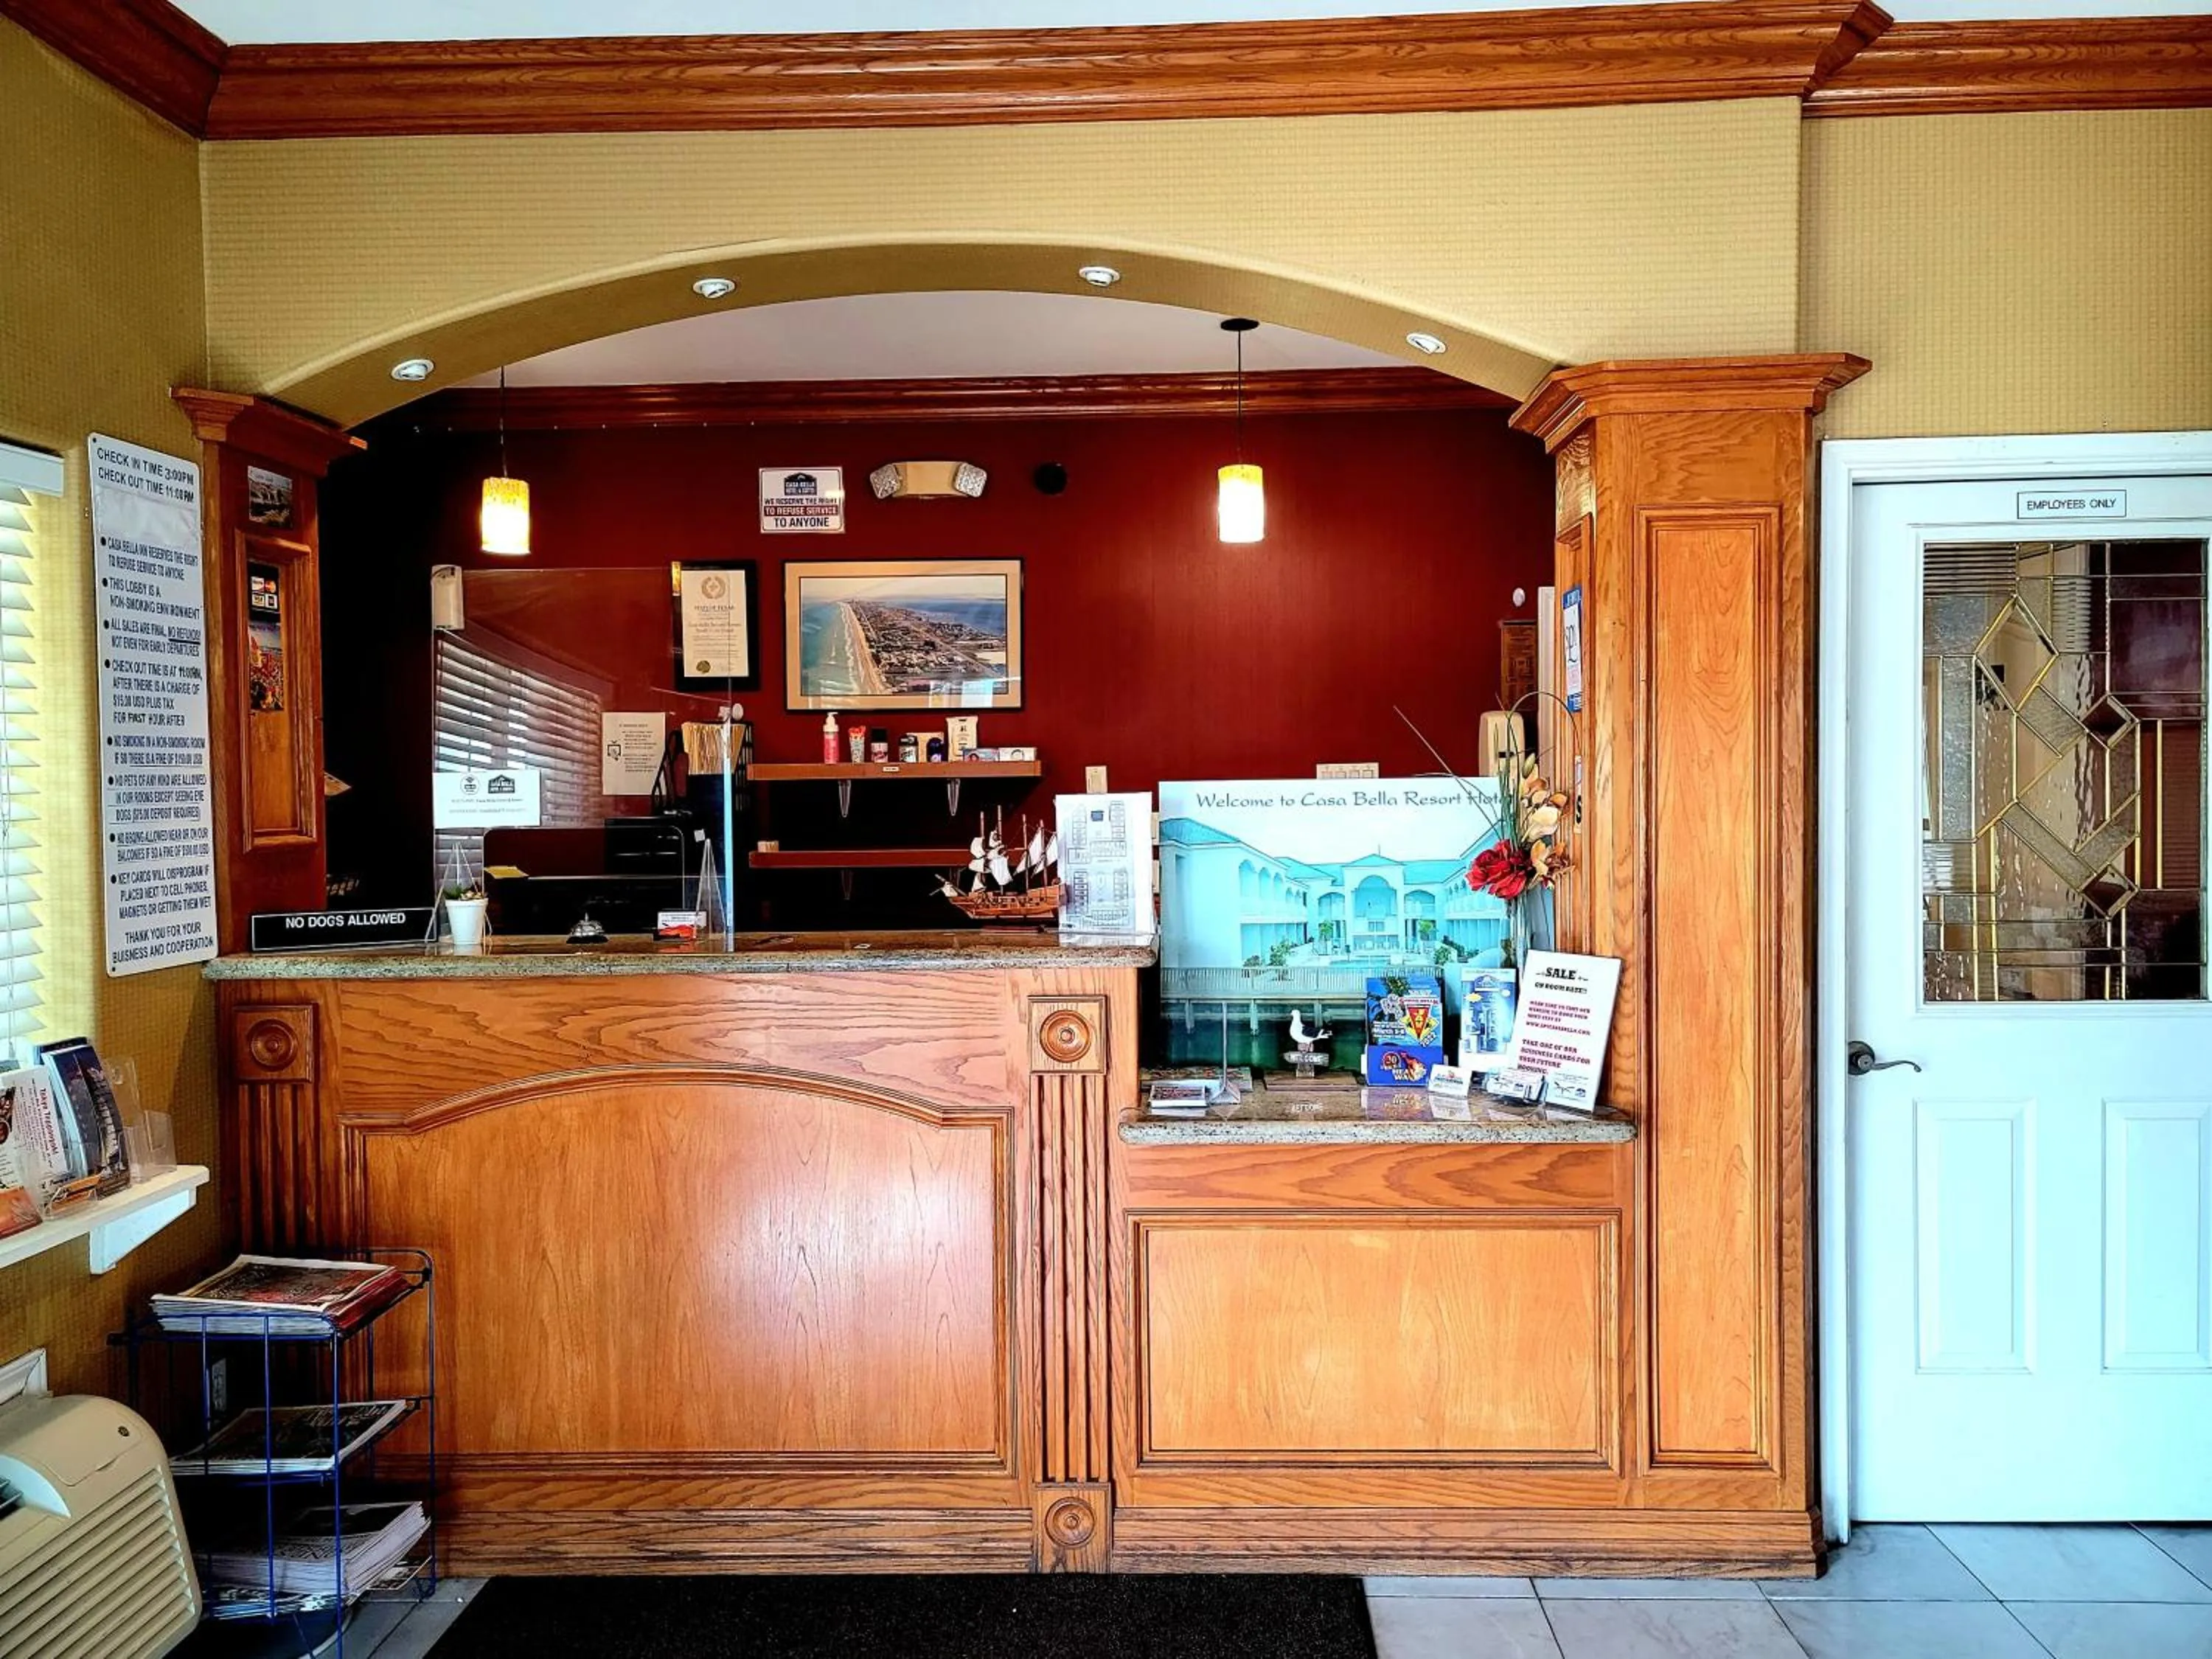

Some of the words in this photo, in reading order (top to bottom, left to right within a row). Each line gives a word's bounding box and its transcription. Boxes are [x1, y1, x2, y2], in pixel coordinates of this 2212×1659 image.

[97, 448, 129, 467] CHECK
[131, 456, 140, 470] IN
[143, 461, 163, 476] TIME
[98, 467, 126, 484] CHECK
[128, 476, 144, 489] OUT
[147, 479, 163, 495] TIME
[2028, 499, 2085, 510] EMPLOYEES
[2090, 498, 2116, 509] ONLY
[774, 518, 786, 527] TO
[789, 518, 829, 526] ANYONE
[109, 554, 116, 566] TO
[158, 564, 164, 577] TO
[109, 577, 124, 591] THIS
[125, 580, 146, 595] LOBBY
[148, 585, 154, 597] IS
[156, 585, 161, 597] A
[111, 594, 155, 613] NON-SMOKING
[156, 602, 200, 619] ENVIRONMENT
[111, 618, 121, 630] ALL
[122, 619, 139, 633] SALES
[140, 622, 150, 634] ARE
[168, 625, 175, 638] NO
[111, 636, 122, 647] NOT
[124, 636, 137, 650] EVEN
[139, 639, 149, 651] FOR
[112, 660, 134, 672] CHECK
[135, 662, 147, 673] OUT
[148, 664, 161, 676] TIME
[162, 665, 168, 676] IS
[170, 666, 177, 677] AT
[114, 677, 132, 689] AFTER
[134, 678, 153, 692] THERE
[155, 681, 160, 692] IS
[161, 681, 166, 692] A
[167, 681, 190, 695] CHARGE
[192, 684, 200, 695] OF
[133, 696, 145, 708] USD
[147, 698, 161, 709] PLUS
[163, 698, 174, 709] TAX
[114, 712, 125, 724] FOR
[167, 714, 185, 726] AFTER
[124, 775, 138, 786] PETS
[139, 775, 146, 786] OF
[147, 775, 156, 786] ANY
[171, 775, 181, 785] ARE
[122, 792, 133, 804] OUR
[1197, 793, 1273, 807] Welcome
[1281, 795, 1295, 807] to
[1301, 793, 1347, 806] Casa
[1352, 790, 1397, 806] Bella
[1403, 790, 1461, 806] Resort
[1467, 790, 1510, 805] Hot
[116, 809, 131, 821] DOGS
[118, 872, 130, 885] KEY
[131, 870, 150, 883] CARDS
[152, 869, 165, 880] WILL
[120, 888, 143, 902] PLACED
[145, 886, 159, 898] NEXT
[161, 886, 168, 897] TO
[170, 883, 184, 896] CELL
[119, 905, 147, 919] MAGNETS
[149, 903, 156, 915] OR
[184, 899, 198, 909] THEM
[286, 917, 304, 928] NO
[308, 915, 344, 928] DOGS
[348, 913, 406, 925] ALLOWED
[125, 929, 149, 944] THANK
[150, 928, 165, 939] YOU
[166, 924, 181, 936] FOR
[183, 922, 201, 934] YOUR
[150, 944, 164, 956] AND
[166, 936, 213, 955] COOPERATION
[1545, 967, 1576, 980] SALE
[1523, 1038, 1538, 1046] TAKE
